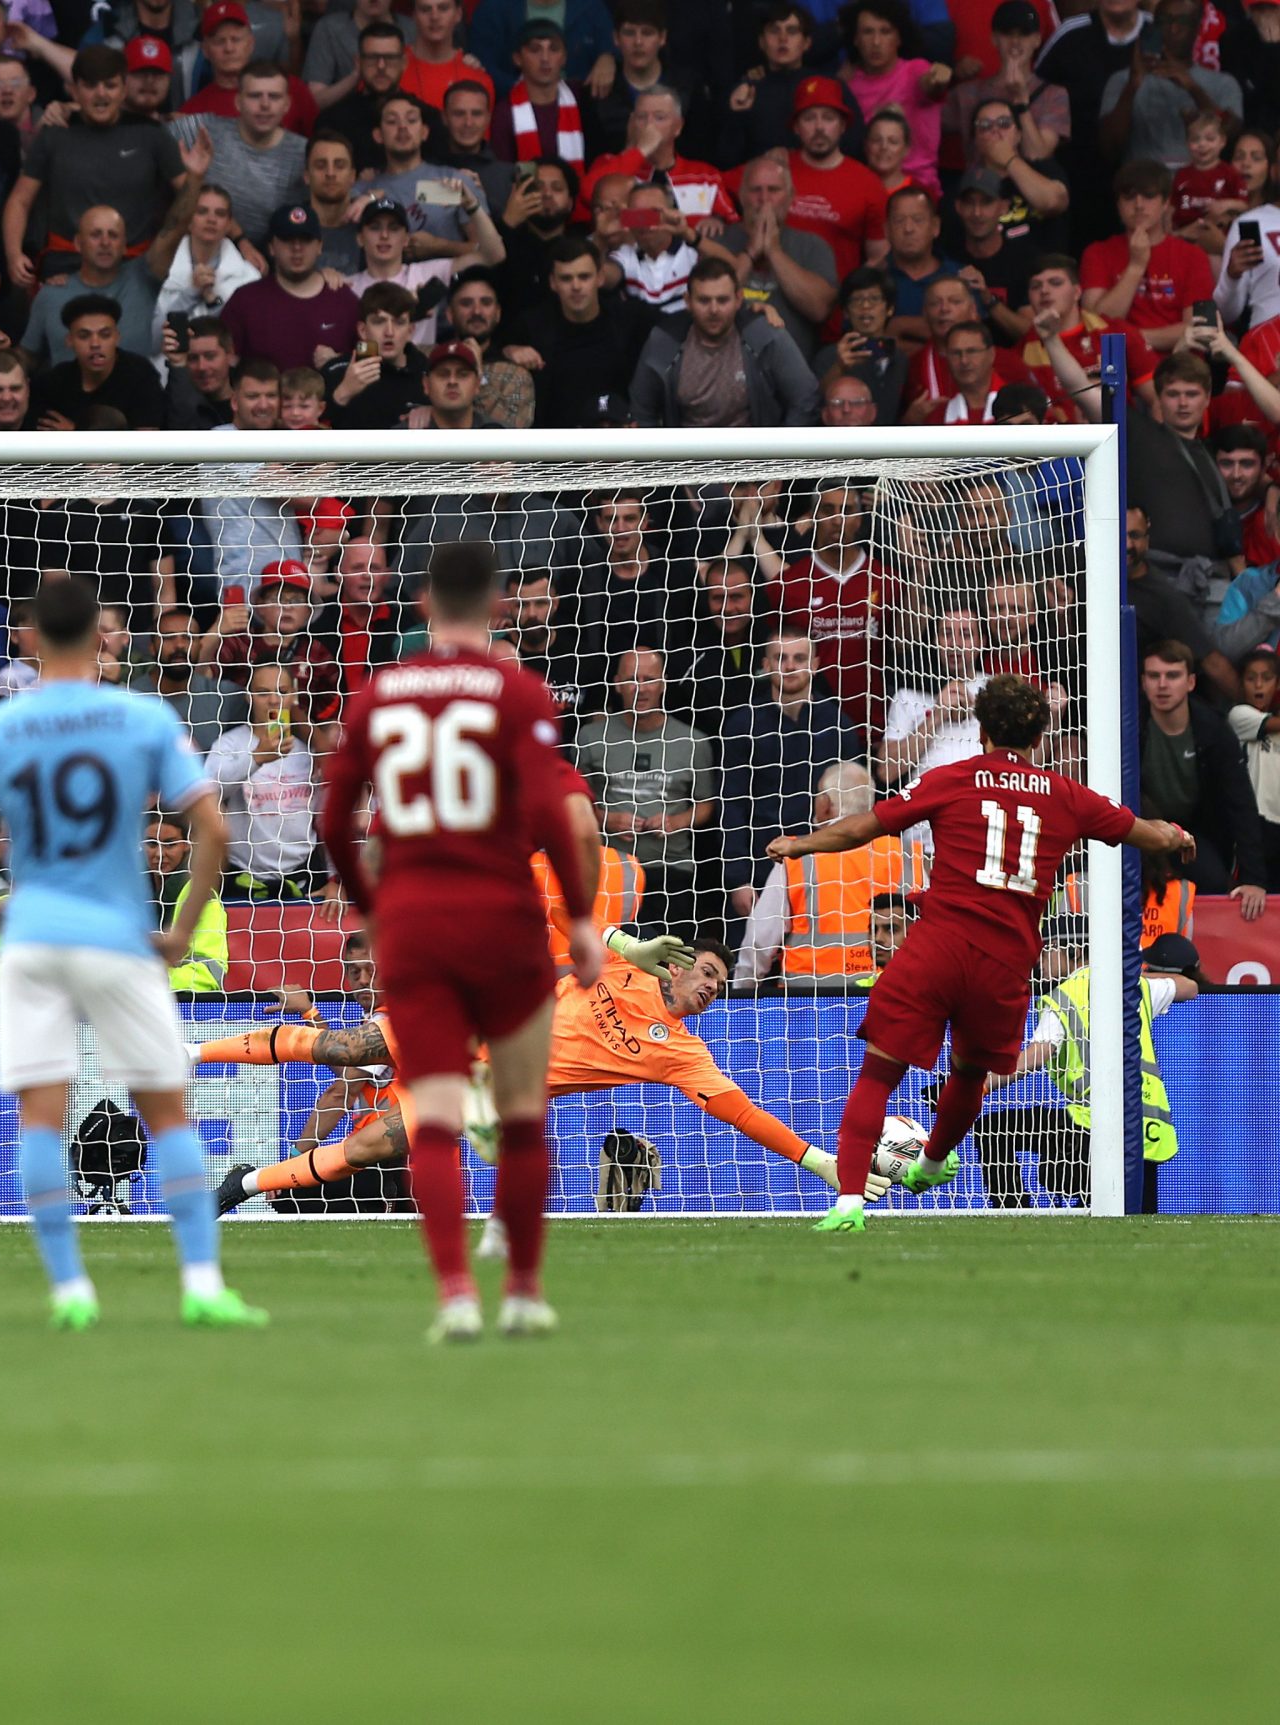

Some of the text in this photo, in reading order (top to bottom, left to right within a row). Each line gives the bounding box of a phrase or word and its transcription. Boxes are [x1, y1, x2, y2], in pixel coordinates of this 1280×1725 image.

[813, 616, 865, 628] Standard
[369, 700, 499, 836] 26
[975, 769, 1051, 796] M.SALAH
[7, 753, 119, 862] 19
[976, 800, 1044, 896] 11
[850, 949, 871, 958] Safe
[589, 1000, 621, 1051] AIRWAYS
[596, 982, 641, 1055] ETIHAD
